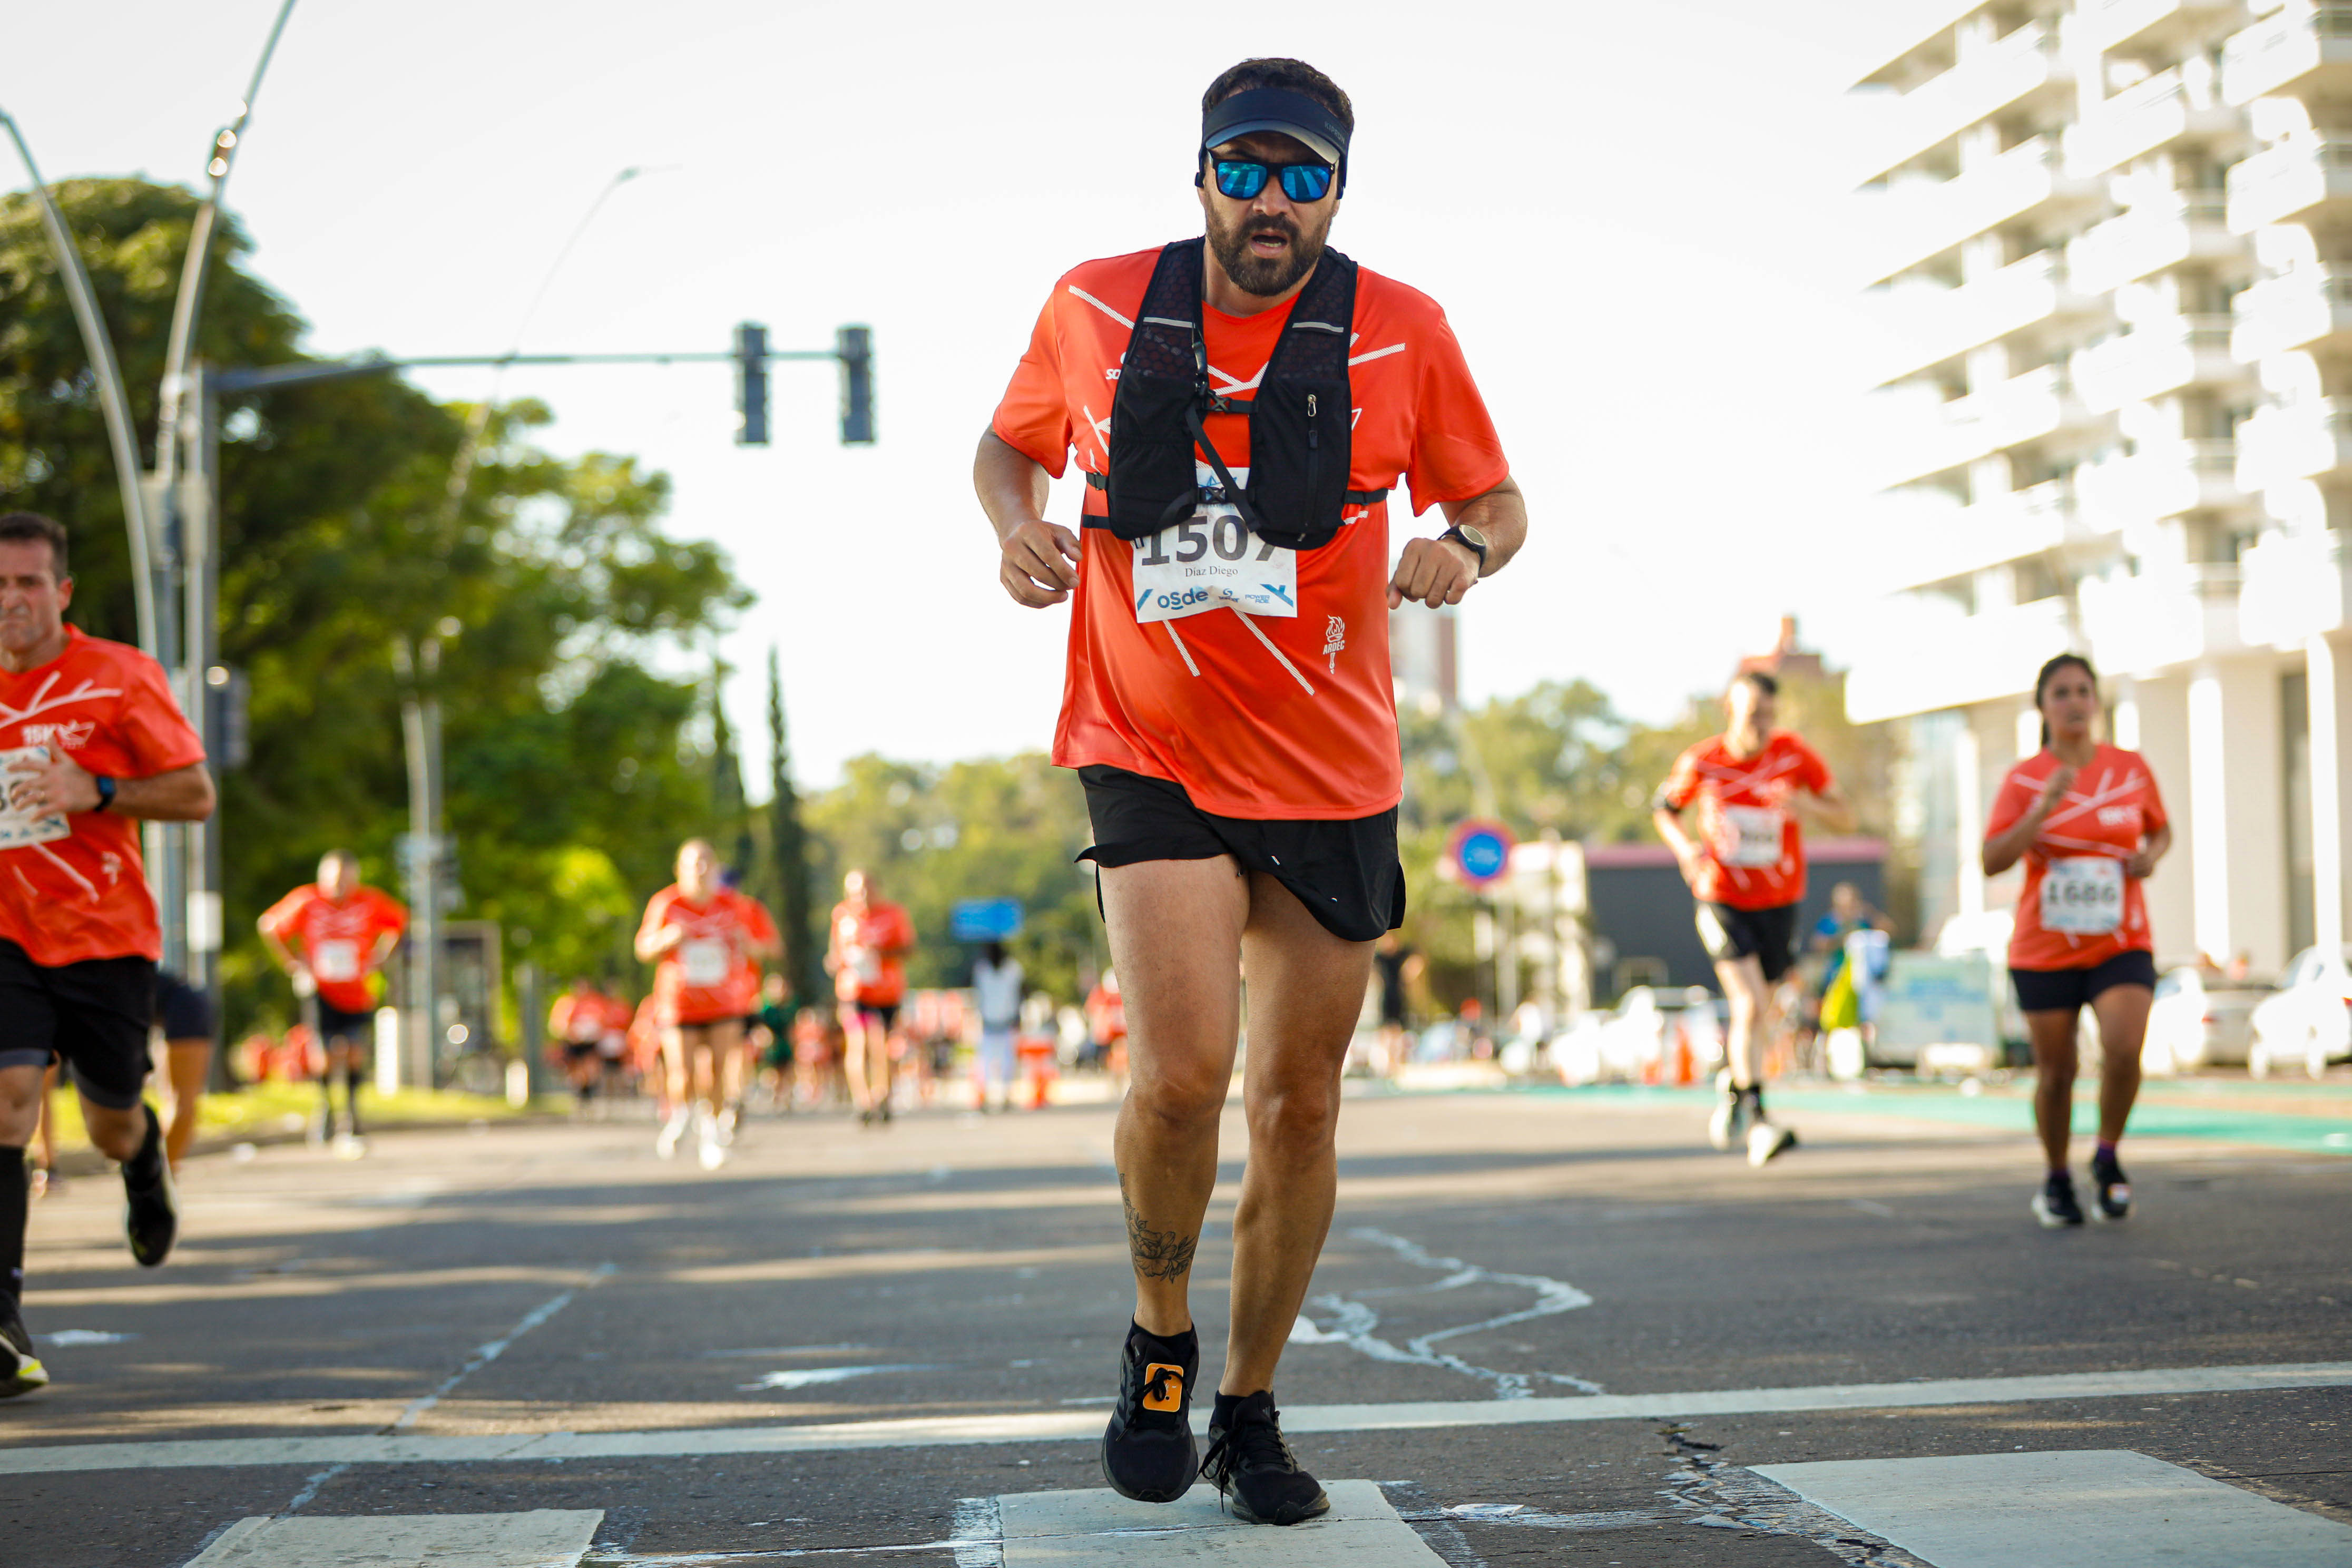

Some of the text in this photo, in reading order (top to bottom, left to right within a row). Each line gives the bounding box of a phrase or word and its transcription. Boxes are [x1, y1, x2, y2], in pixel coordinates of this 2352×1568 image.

[1324, 122, 1345, 144] KIPRUN
[1142, 515, 1275, 566] 150
[1185, 566, 1238, 577] Díaz Diego
[1157, 587, 1209, 610] osde
